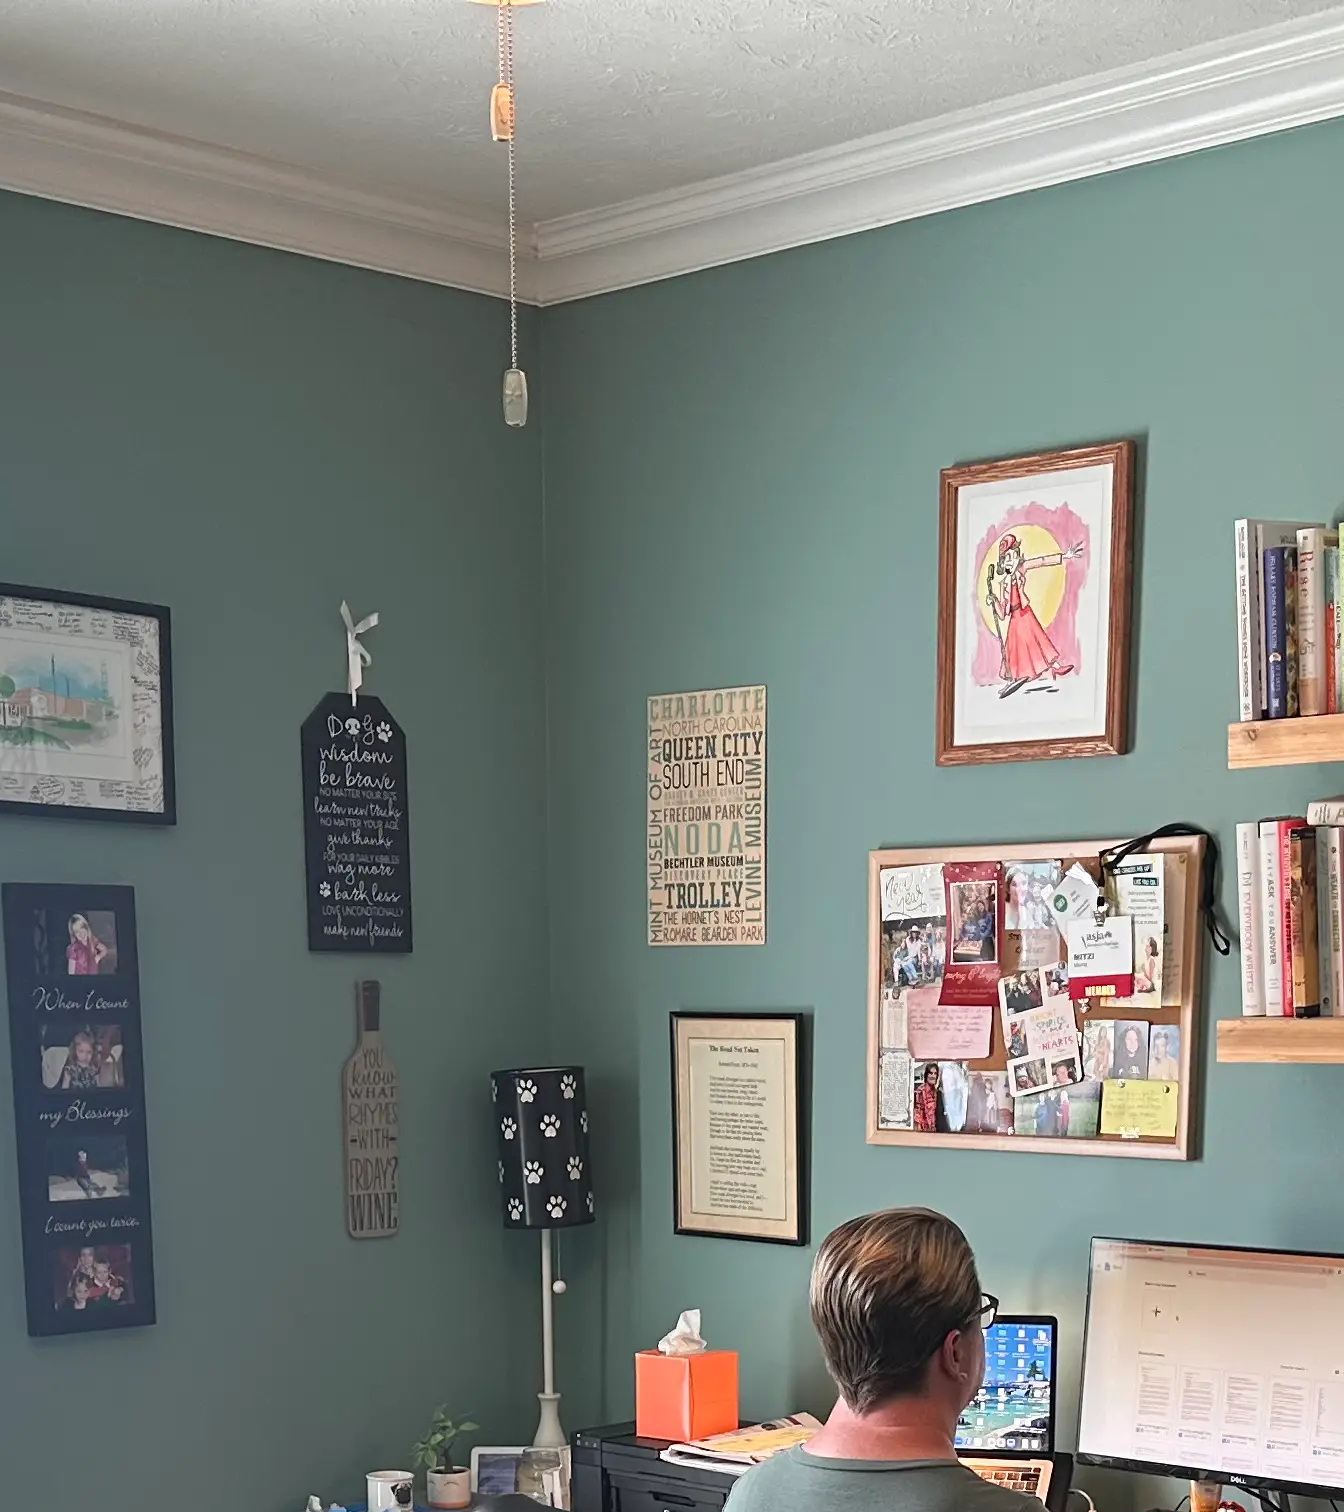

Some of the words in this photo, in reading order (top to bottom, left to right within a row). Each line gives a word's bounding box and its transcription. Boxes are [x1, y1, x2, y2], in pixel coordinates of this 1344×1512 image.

[650, 688, 764, 721] CHARLOTTE
[662, 720, 700, 737] NORTH
[703, 715, 762, 734] CAROLINA
[320, 746, 394, 765] wisdom
[649, 724, 663, 766] ART
[662, 735, 717, 764] QUEEN
[722, 731, 763, 757] CITY
[320, 762, 342, 787] be
[345, 765, 396, 790] brave
[649, 773, 663, 801] OF
[663, 761, 710, 790] SOUTH
[716, 758, 745, 787] END
[319, 787, 331, 797] NO
[745, 758, 762, 847] MUSEUM
[319, 817, 332, 827] NO
[663, 806, 711, 823] FREEDOM
[715, 803, 744, 820] PARK
[649, 809, 663, 890] MUSEUM
[663, 822, 744, 857] NODA
[663, 856, 704, 870] BECHTLER
[707, 855, 744, 868] MUSEUM
[716, 868, 744, 880] PLACE
[372, 884, 402, 903] less
[664, 881, 744, 910] TROLLEY
[745, 854, 762, 923] LEVINE
[1267, 879, 1276, 898] ASK
[650, 899, 663, 943] MINT
[663, 911, 678, 925] THE
[682, 910, 719, 924] HORNET'S
[723, 910, 745, 924] NEST
[1242, 891, 1252, 952] EVERYBODY
[662, 927, 697, 942] ROMARE
[701, 926, 737, 942] BEARDEN
[740, 926, 764, 941] PARK
[1268, 926, 1277, 965] ANSWER
[1245, 956, 1255, 993] WRITES
[32, 986, 82, 1013] When
[96, 996, 130, 1011] count
[351, 1059, 397, 1087] know
[362, 1049, 383, 1070] YOU
[348, 1086, 397, 1100] WHAT
[39, 1109, 65, 1133] my
[64, 1098, 132, 1130] Blessings
[348, 1102, 398, 1126] RHYMES
[349, 1192, 399, 1233] WINE
[54, 1218, 84, 1234] count
[85, 1220, 108, 1241] you
[1230, 1476, 1247, 1484] DELL
